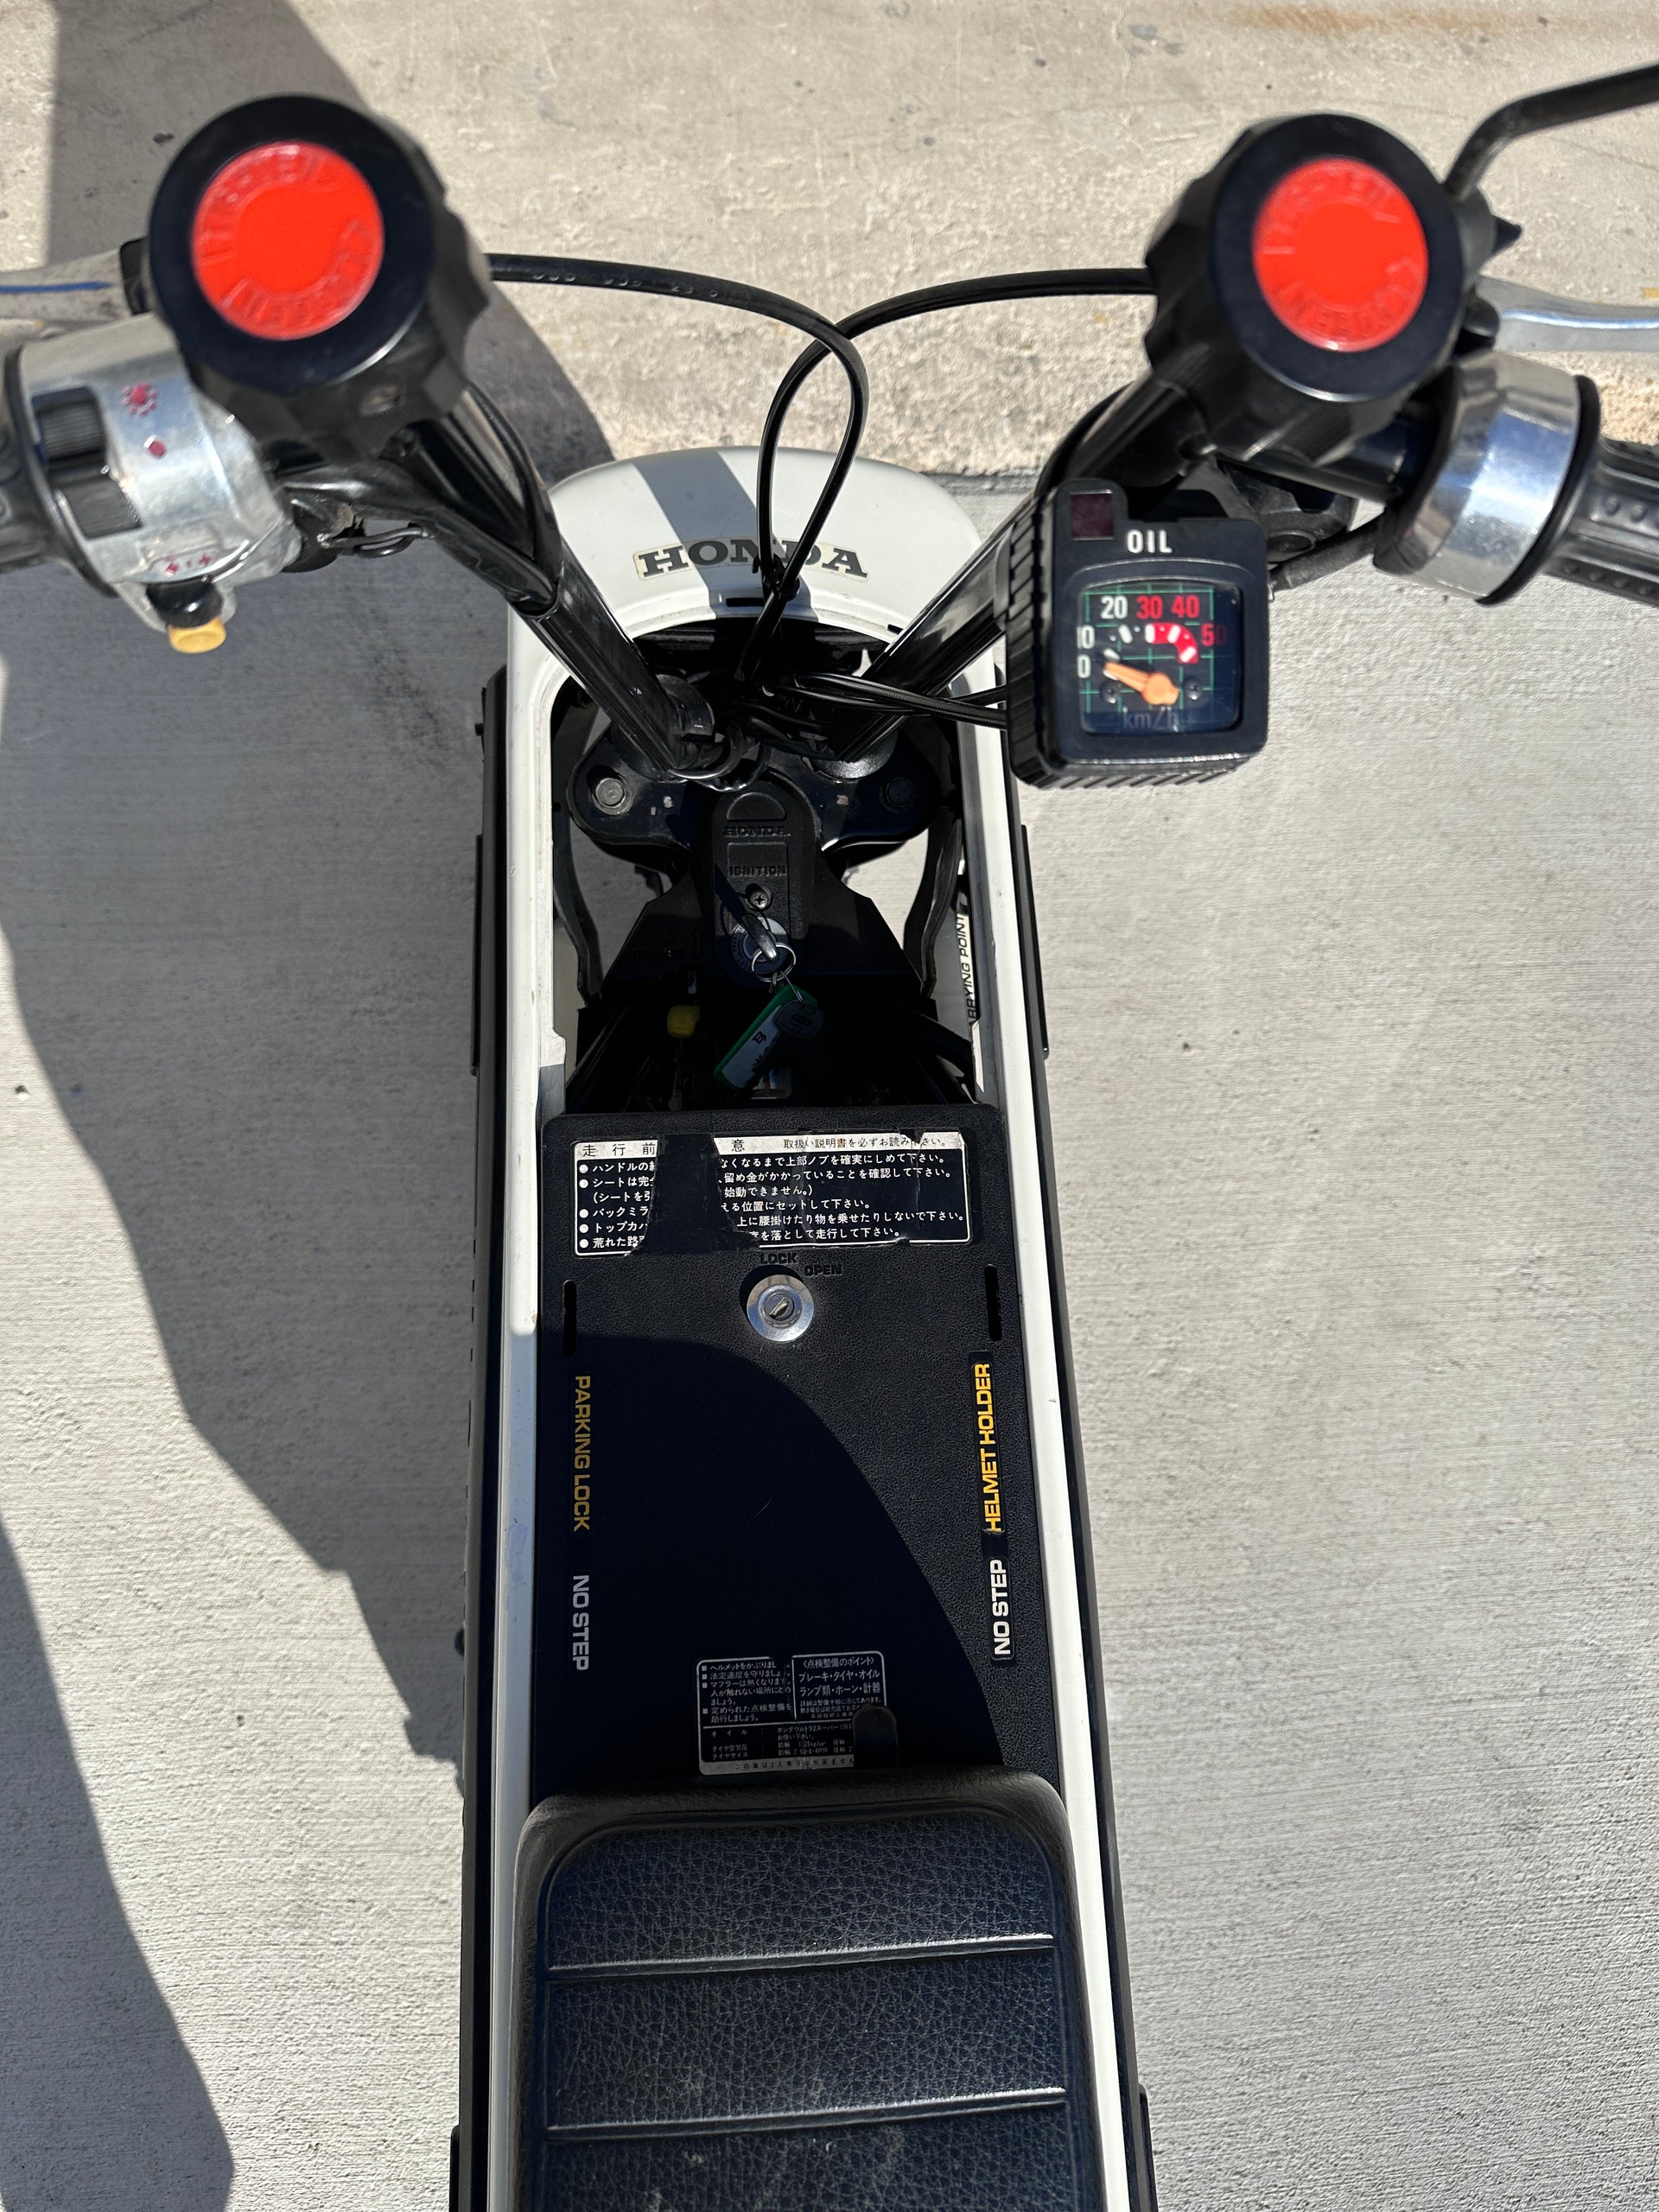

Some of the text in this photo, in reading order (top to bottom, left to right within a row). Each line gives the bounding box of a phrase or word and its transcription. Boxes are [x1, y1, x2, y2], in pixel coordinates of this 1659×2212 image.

[1127, 529, 1173, 553] OIL
[639, 539, 868, 578] HONDA
[1100, 594, 1199, 620] 20 30 40
[1077, 623, 1227, 649] 10 50
[1077, 654, 1091, 678] 0
[723, 825, 791, 837] HONDA
[729, 865, 786, 875] IGNITION
[956, 913, 969, 957] POINT
[732, 1139, 745, 1152] 意
[760, 1252, 798, 1264] LOCK
[804, 1264, 842, 1276] OPEN
[574, 1375, 591, 1532] PARKING LOCK
[974, 1363, 1001, 1533] HELMET HOLDER
[990, 1559, 1011, 1655] NO STEP
[573, 1574, 589, 1671] NO STEP
